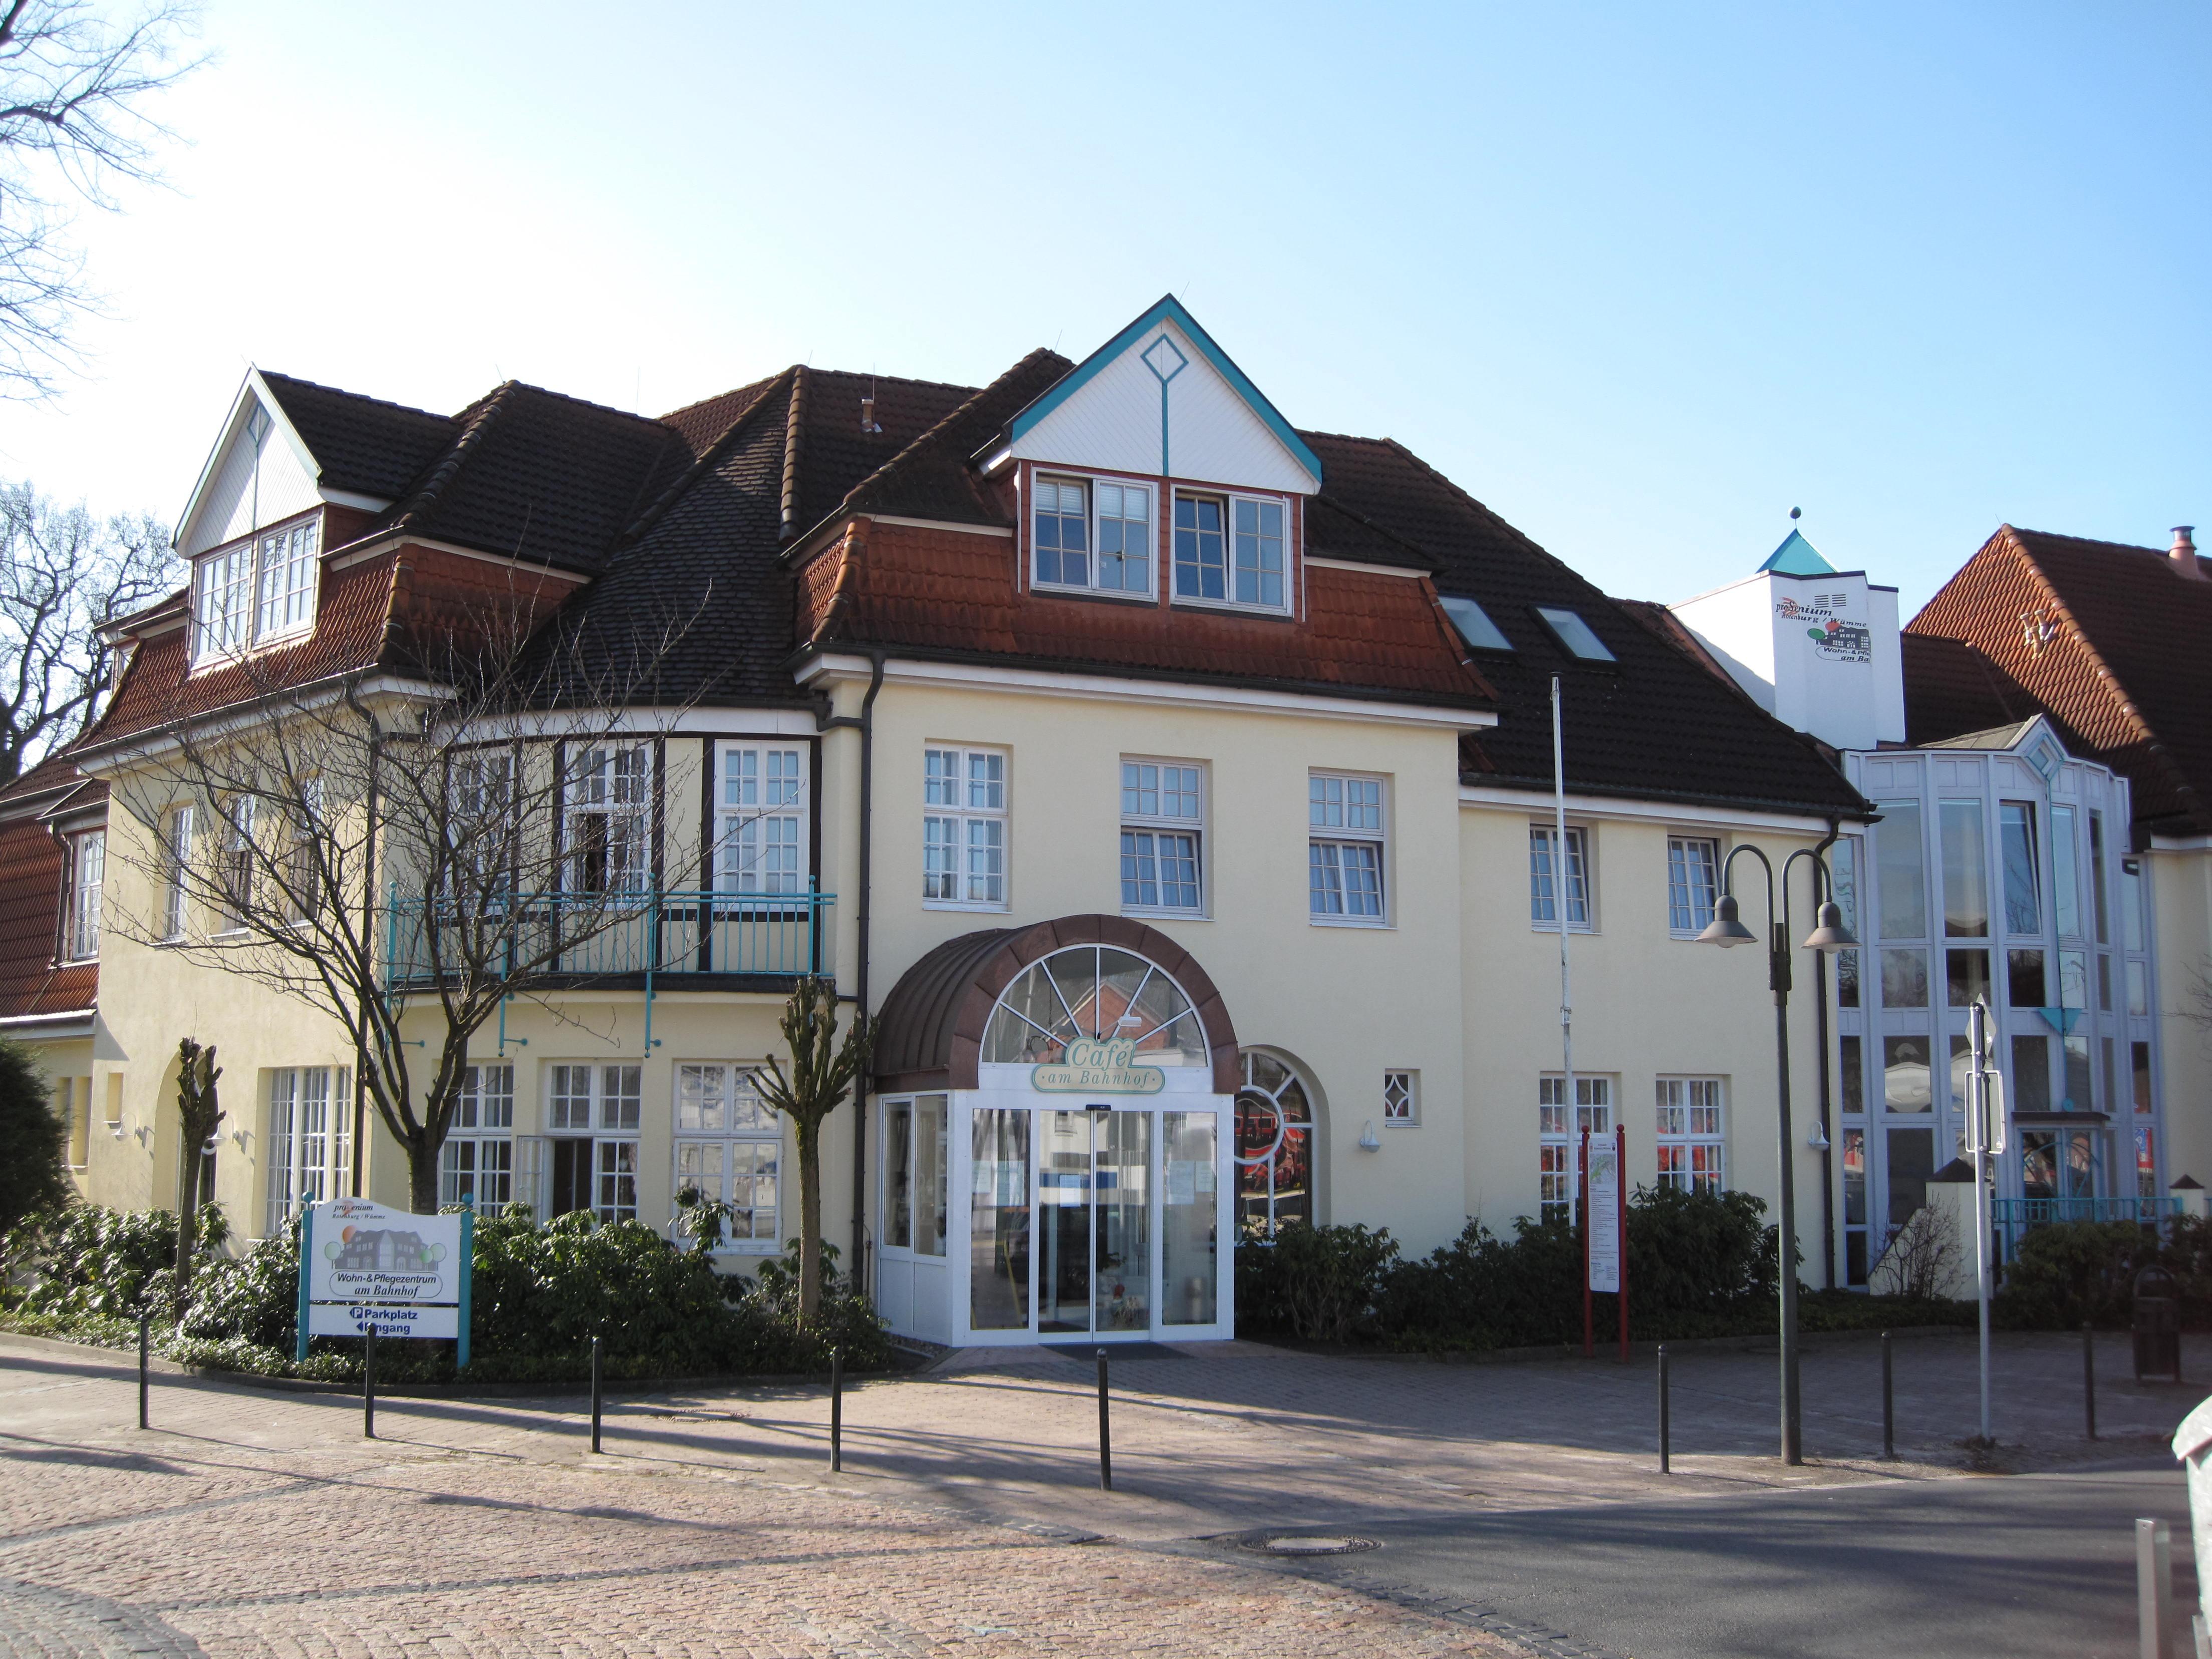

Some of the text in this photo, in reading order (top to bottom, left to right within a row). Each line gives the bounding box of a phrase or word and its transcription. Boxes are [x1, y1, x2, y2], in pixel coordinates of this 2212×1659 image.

[1776, 602, 1832, 616] proSenium
[1781, 613, 1819, 624] Rotenburg
[1830, 618, 1867, 627] Wümme
[1072, 1043, 1128, 1070] Café
[1048, 1070, 1150, 1088] am Bahnhof
[334, 1204, 373, 1212] proenium
[374, 1275, 436, 1284] Pflegezentrum
[355, 1285, 420, 1298] am Bahnhof
[365, 1309, 418, 1321] Parkplatz
